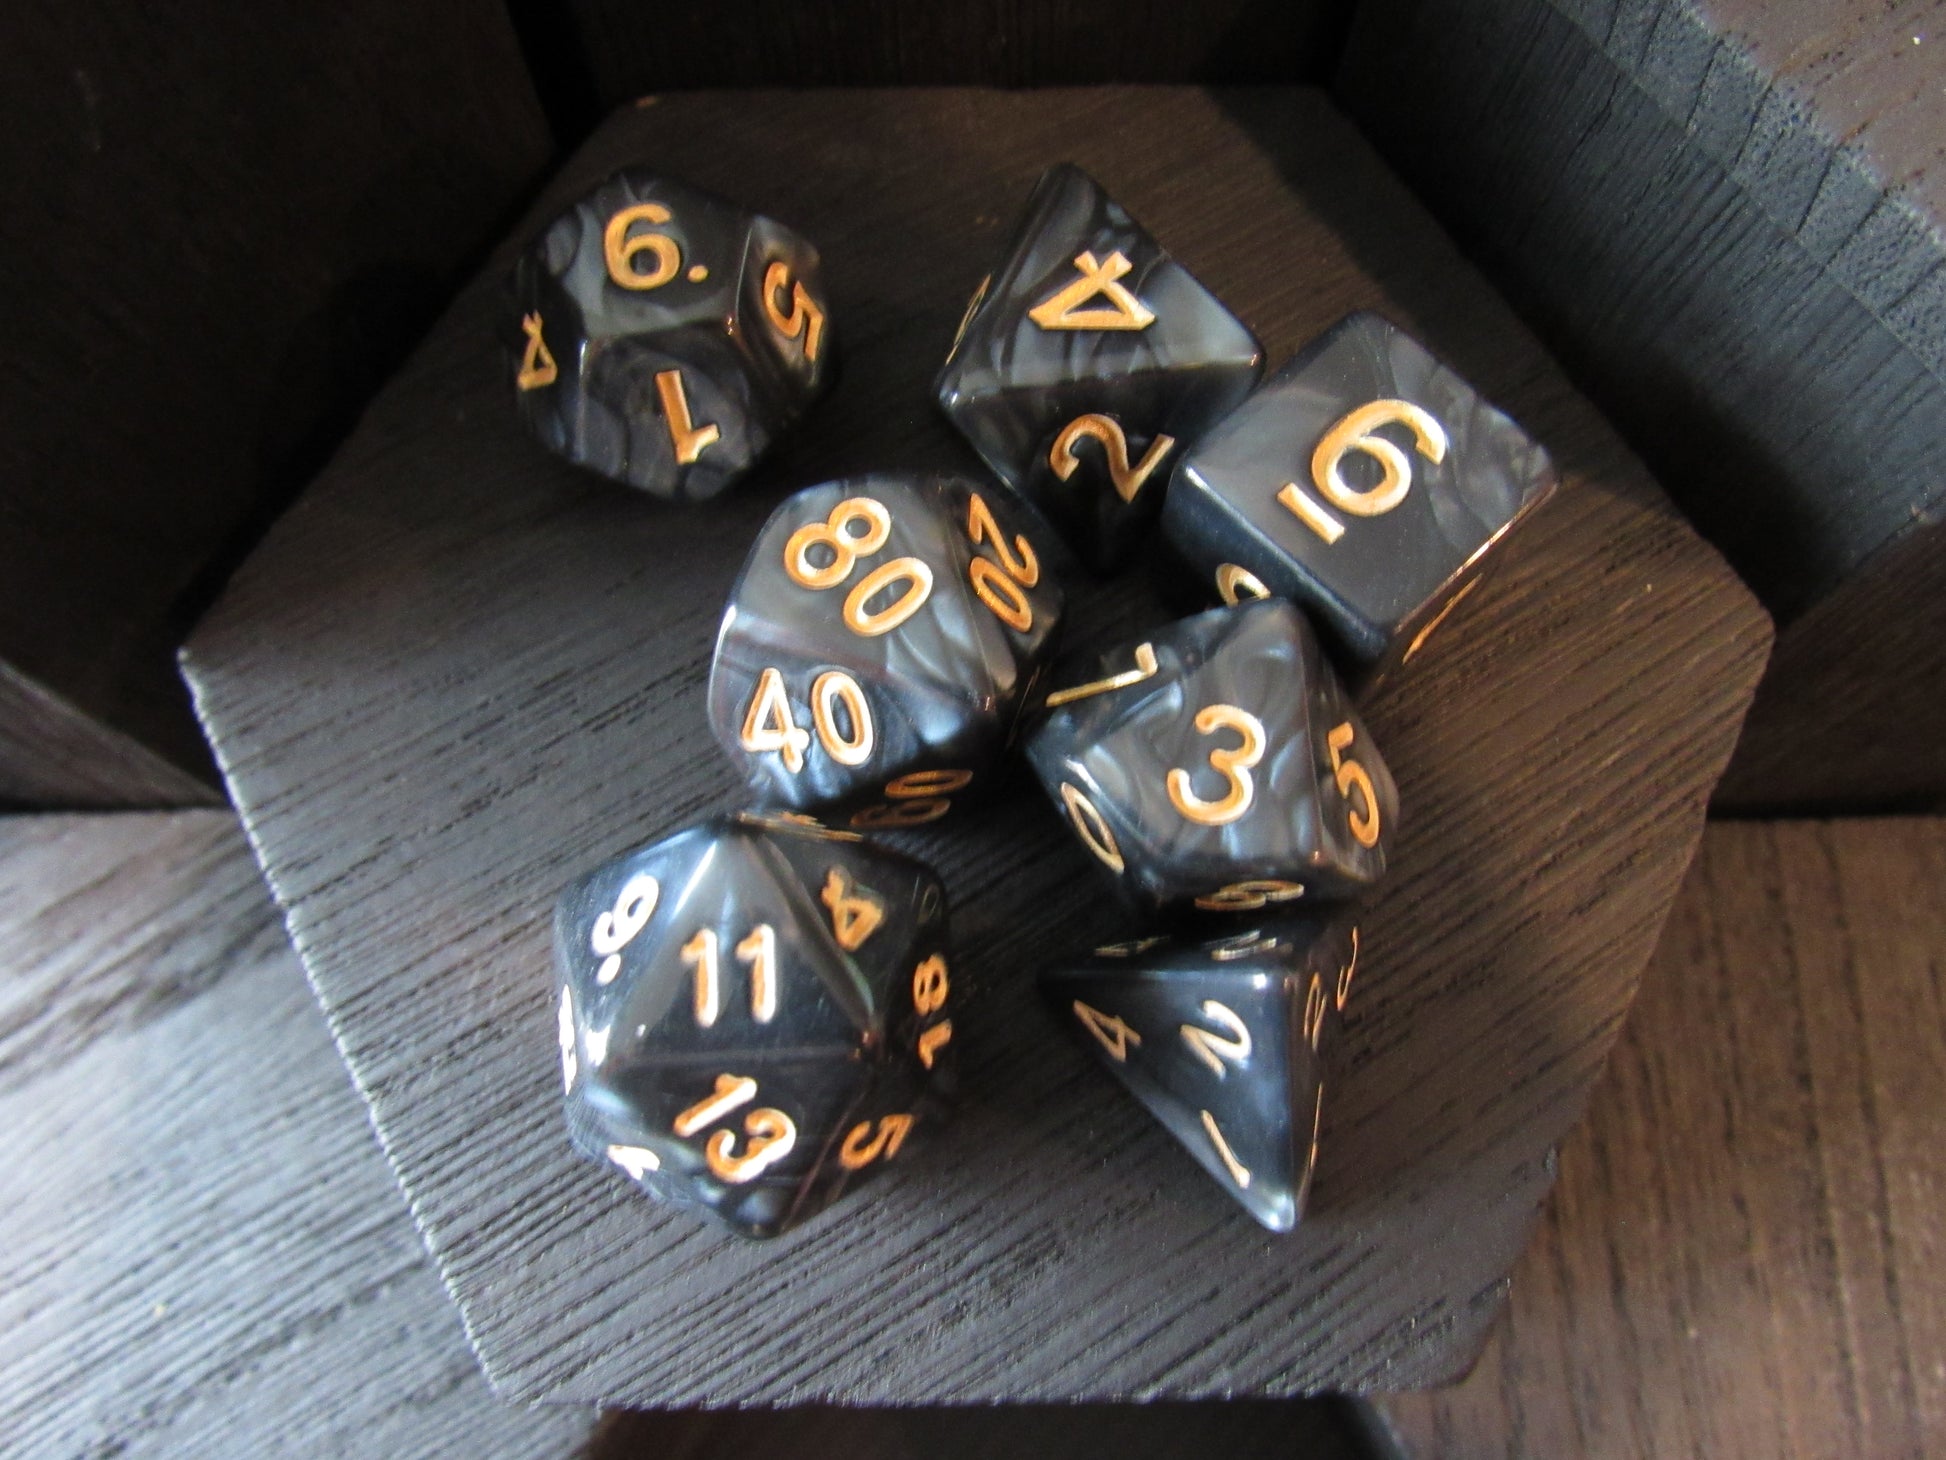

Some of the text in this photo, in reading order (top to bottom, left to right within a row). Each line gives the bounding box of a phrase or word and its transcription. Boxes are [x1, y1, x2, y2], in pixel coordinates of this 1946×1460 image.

[762, 261, 824, 363] 5
[1029, 250, 1156, 331] 4
[517, 309, 559, 391] 4
[655, 369, 720, 465] 1
[1049, 413, 1176, 503] 2
[783, 496, 934, 638] 80
[968, 492, 1039, 633] 20
[740, 666, 875, 774] 40
[1166, 704, 1267, 826] 3
[1327, 721, 1380, 849] 5
[821, 864, 885, 952] 4
[680, 921, 778, 1029] 11
[1073, 999, 1142, 1063] 4
[1179, 999, 1252, 1080] 2
[673, 1072, 798, 1185] 13
[838, 1112, 916, 1172] 5
[1201, 1109, 1251, 1189] 1
